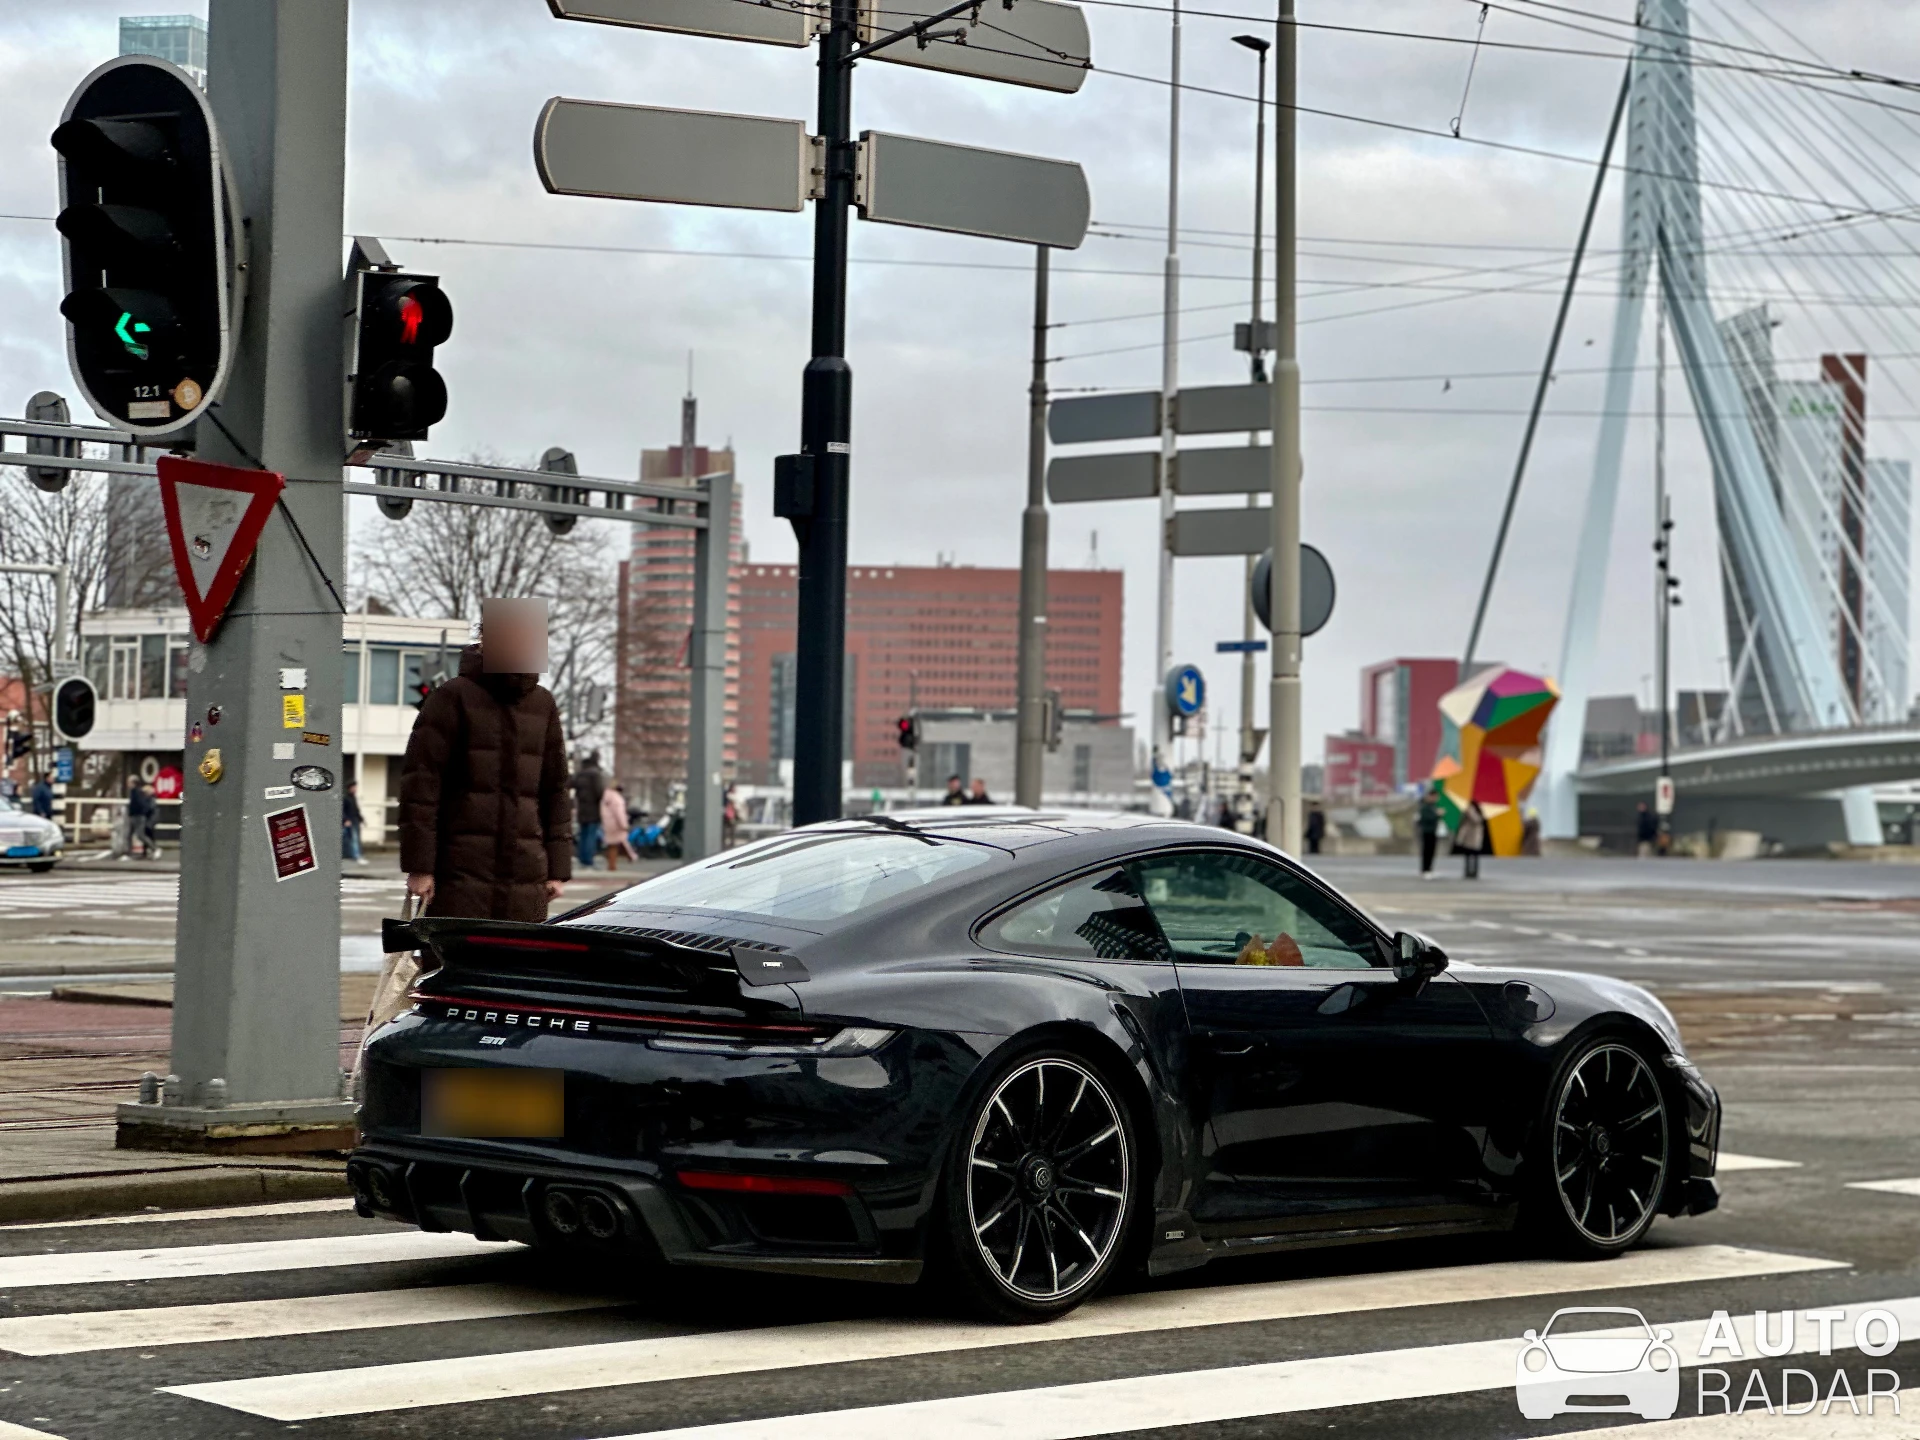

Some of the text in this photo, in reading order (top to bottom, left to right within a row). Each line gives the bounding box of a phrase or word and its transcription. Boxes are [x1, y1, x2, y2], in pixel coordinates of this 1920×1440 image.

[134, 385, 160, 398] 12.1
[447, 1008, 590, 1031] PORSCHE
[479, 1036, 506, 1045] 911
